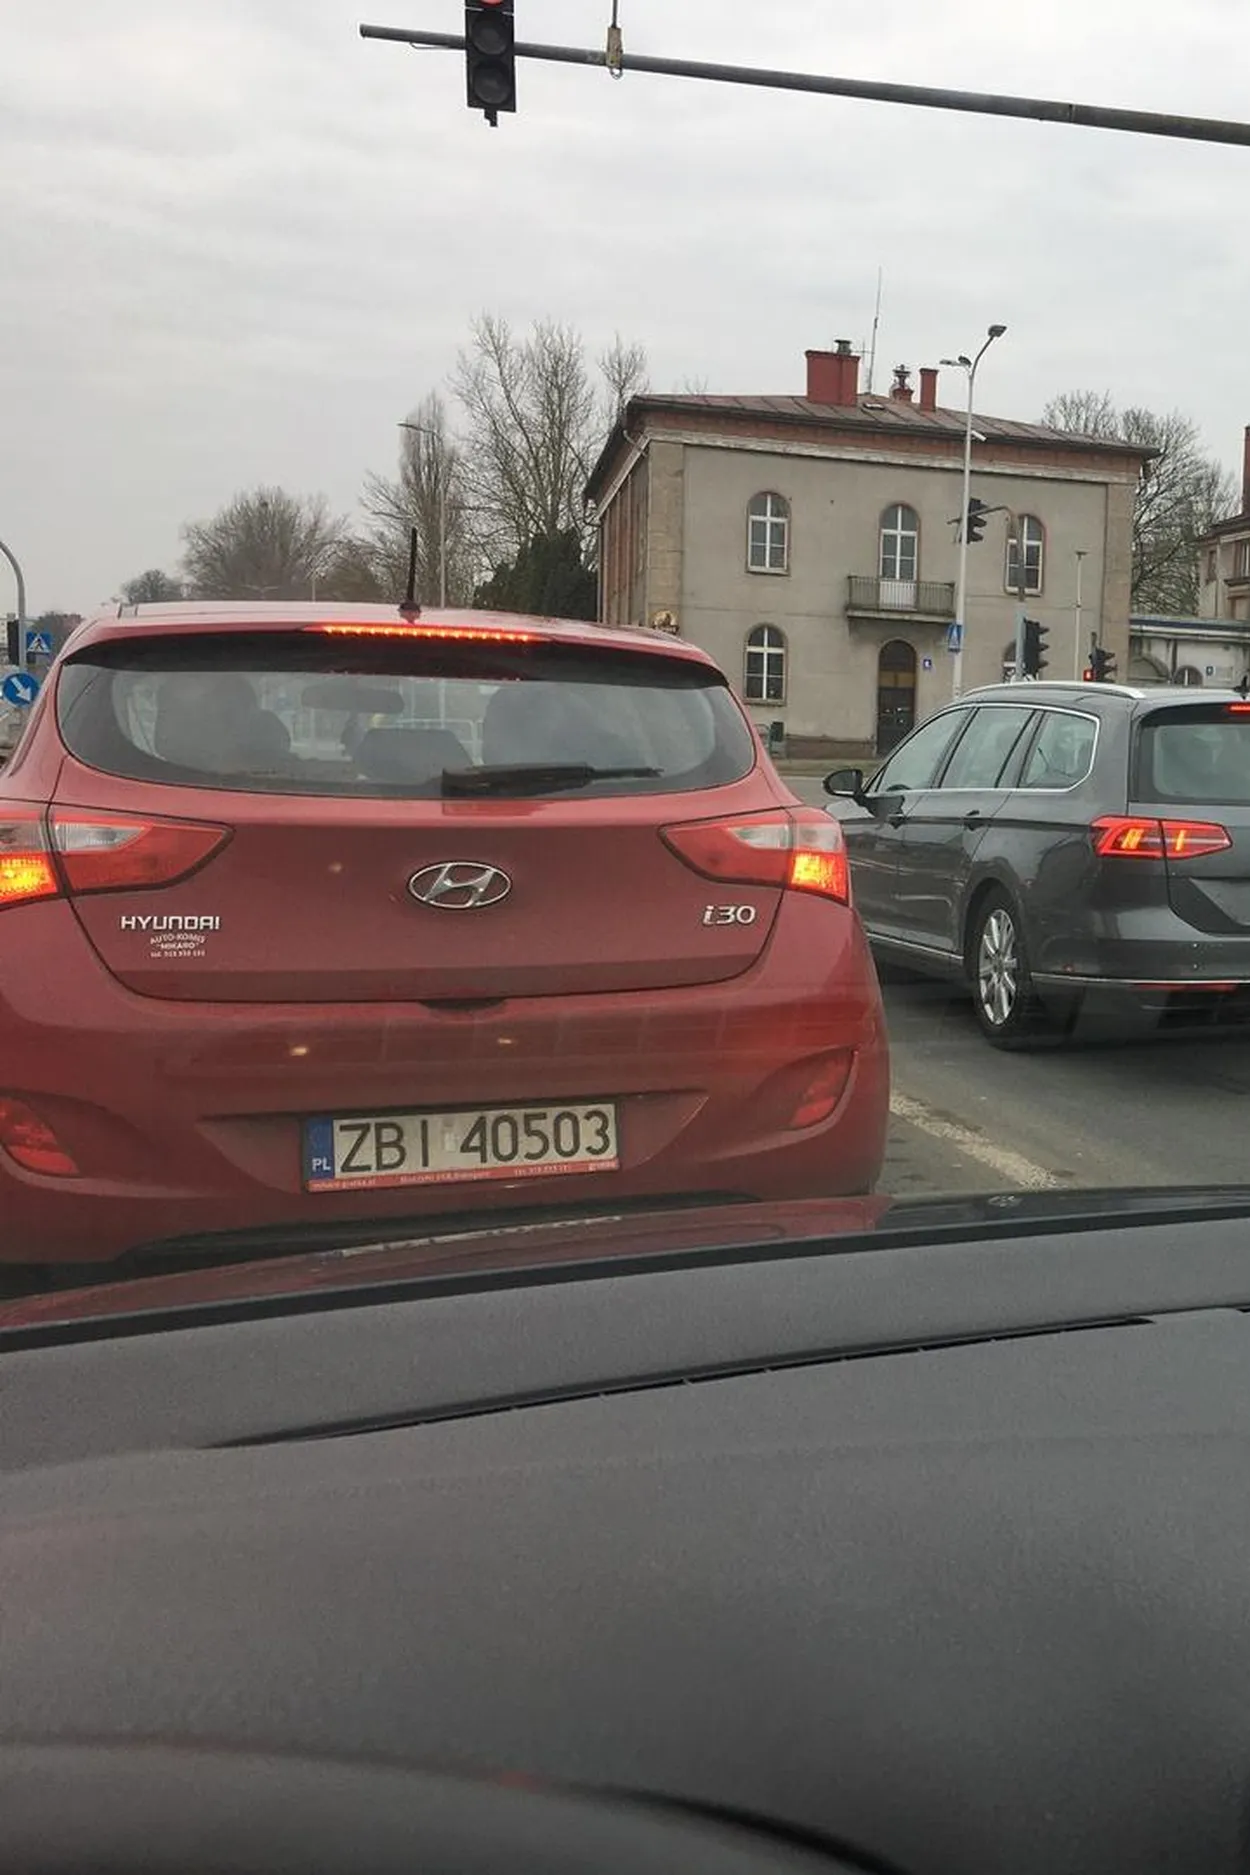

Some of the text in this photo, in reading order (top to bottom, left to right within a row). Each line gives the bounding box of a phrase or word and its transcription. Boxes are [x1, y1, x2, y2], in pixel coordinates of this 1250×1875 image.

[121, 915, 220, 930] HYUNDAI
[702, 904, 756, 925] i30
[338, 1109, 612, 1173] ZBI 40503
[311, 1157, 332, 1172] PL
